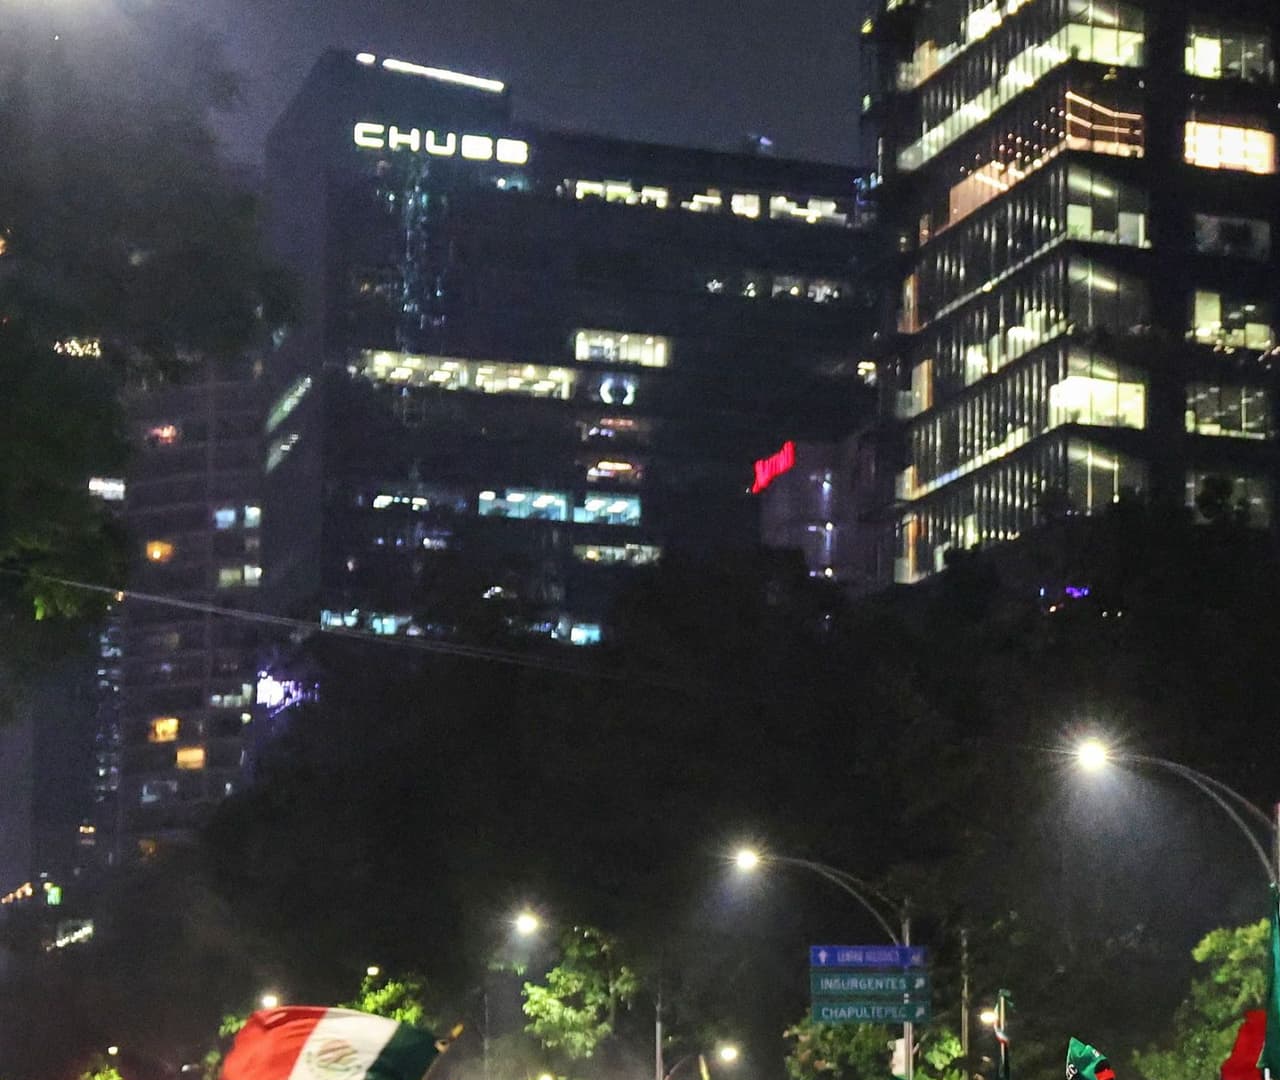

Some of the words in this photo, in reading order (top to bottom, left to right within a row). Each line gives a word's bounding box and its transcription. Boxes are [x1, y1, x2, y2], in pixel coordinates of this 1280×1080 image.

[354, 122, 528, 164] CHUBB
[820, 978, 907, 990] INSURGENTES
[821, 1007, 907, 1018] CHAPULTEPEC
